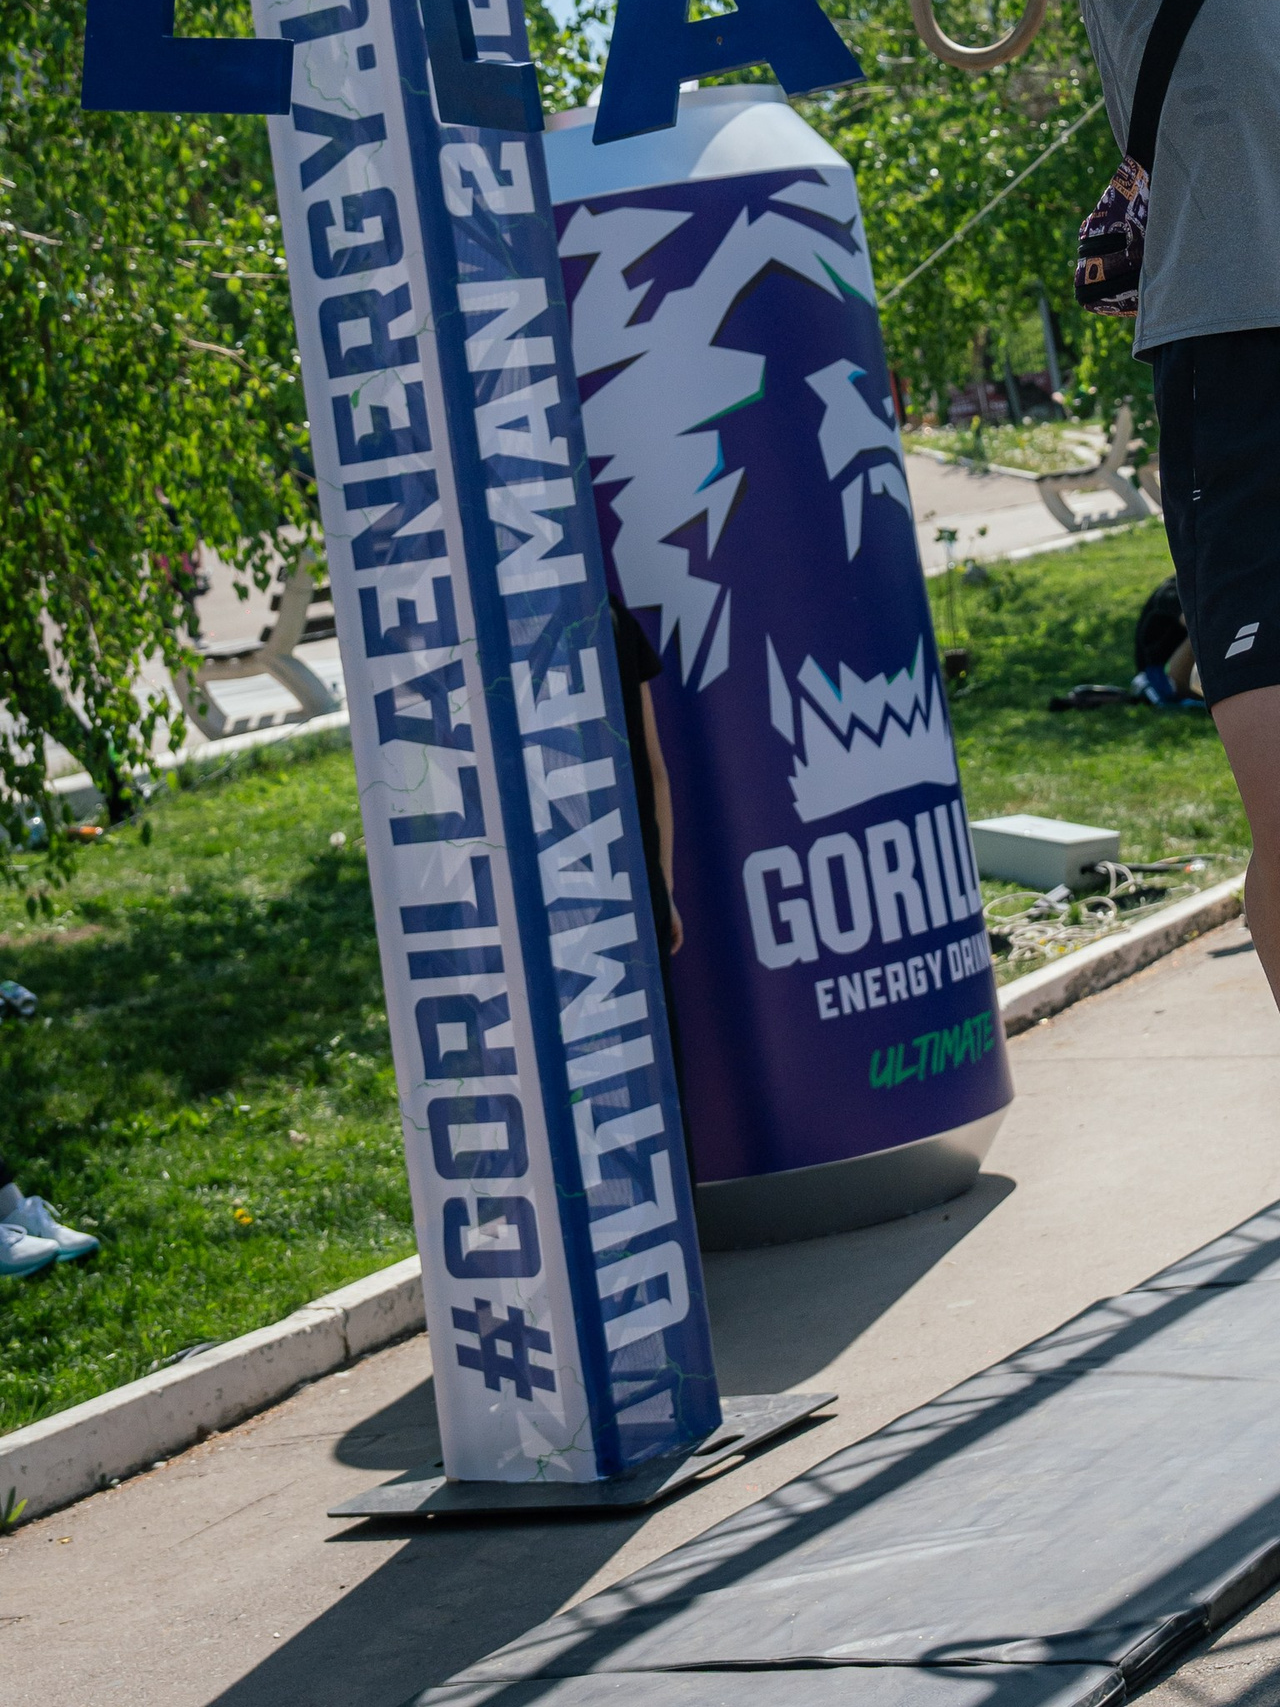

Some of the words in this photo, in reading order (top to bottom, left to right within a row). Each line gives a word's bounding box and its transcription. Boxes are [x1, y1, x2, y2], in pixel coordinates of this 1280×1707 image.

[457, 279, 587, 596] MAN
[510, 647, 690, 1350] ULTIMATE
[815, 950, 943, 1020] ENERGY
[868, 1011, 995, 1090] ULTIMATE
